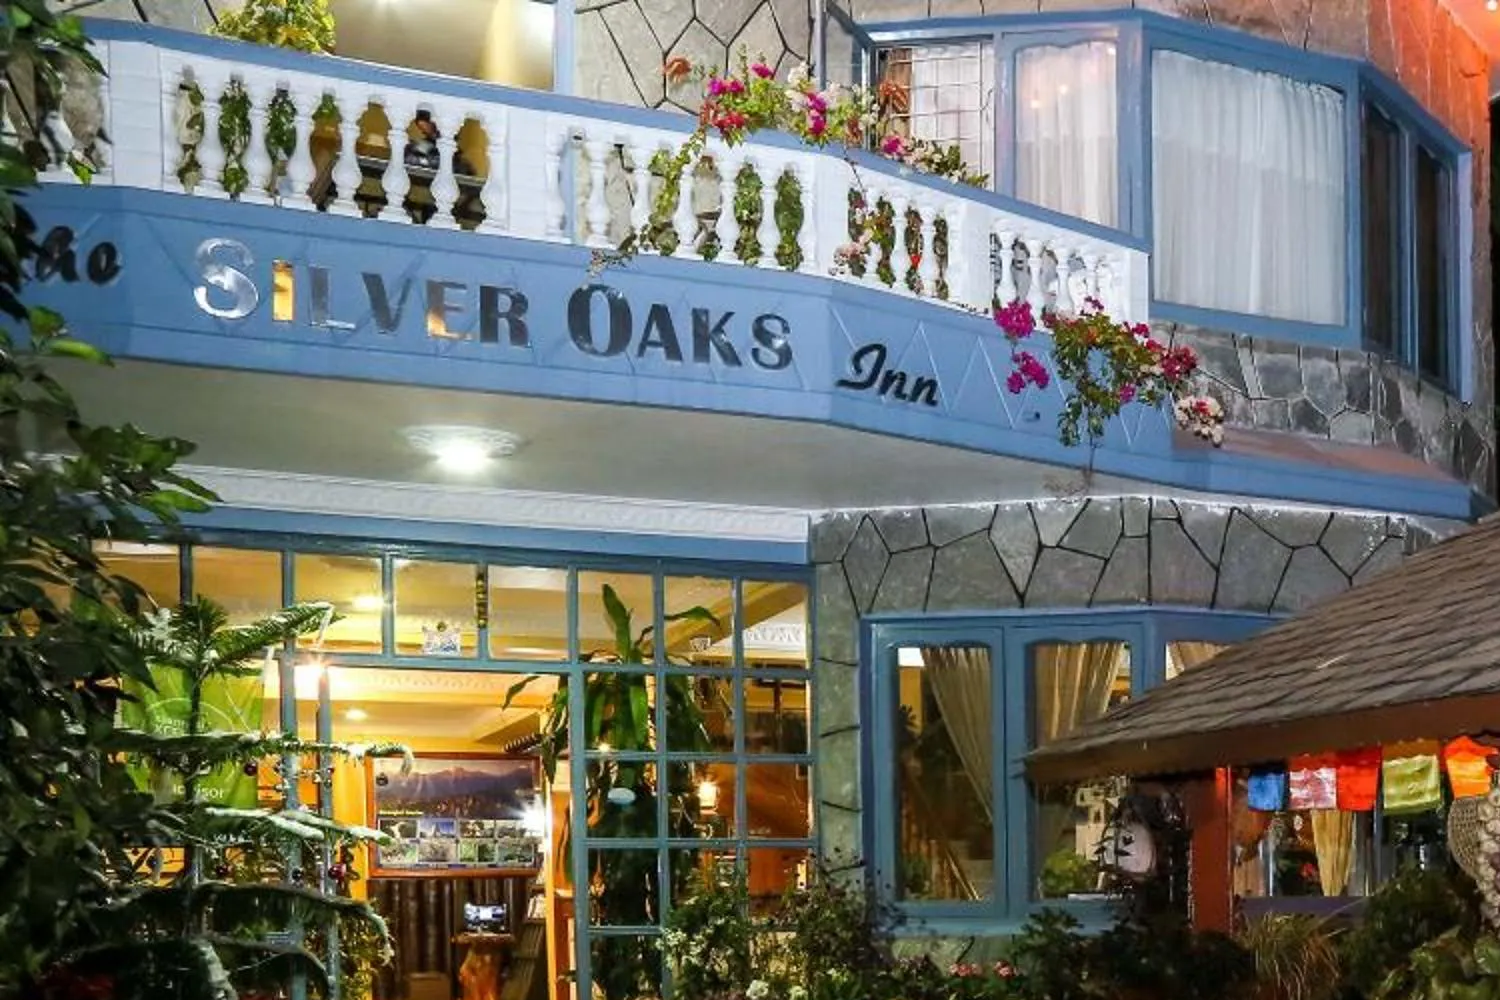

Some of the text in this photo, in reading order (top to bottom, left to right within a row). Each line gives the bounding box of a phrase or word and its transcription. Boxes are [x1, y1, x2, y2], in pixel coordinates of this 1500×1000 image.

[194, 237, 531, 348] SILVER
[567, 283, 793, 370] OAKS
[836, 343, 938, 407] Inn
